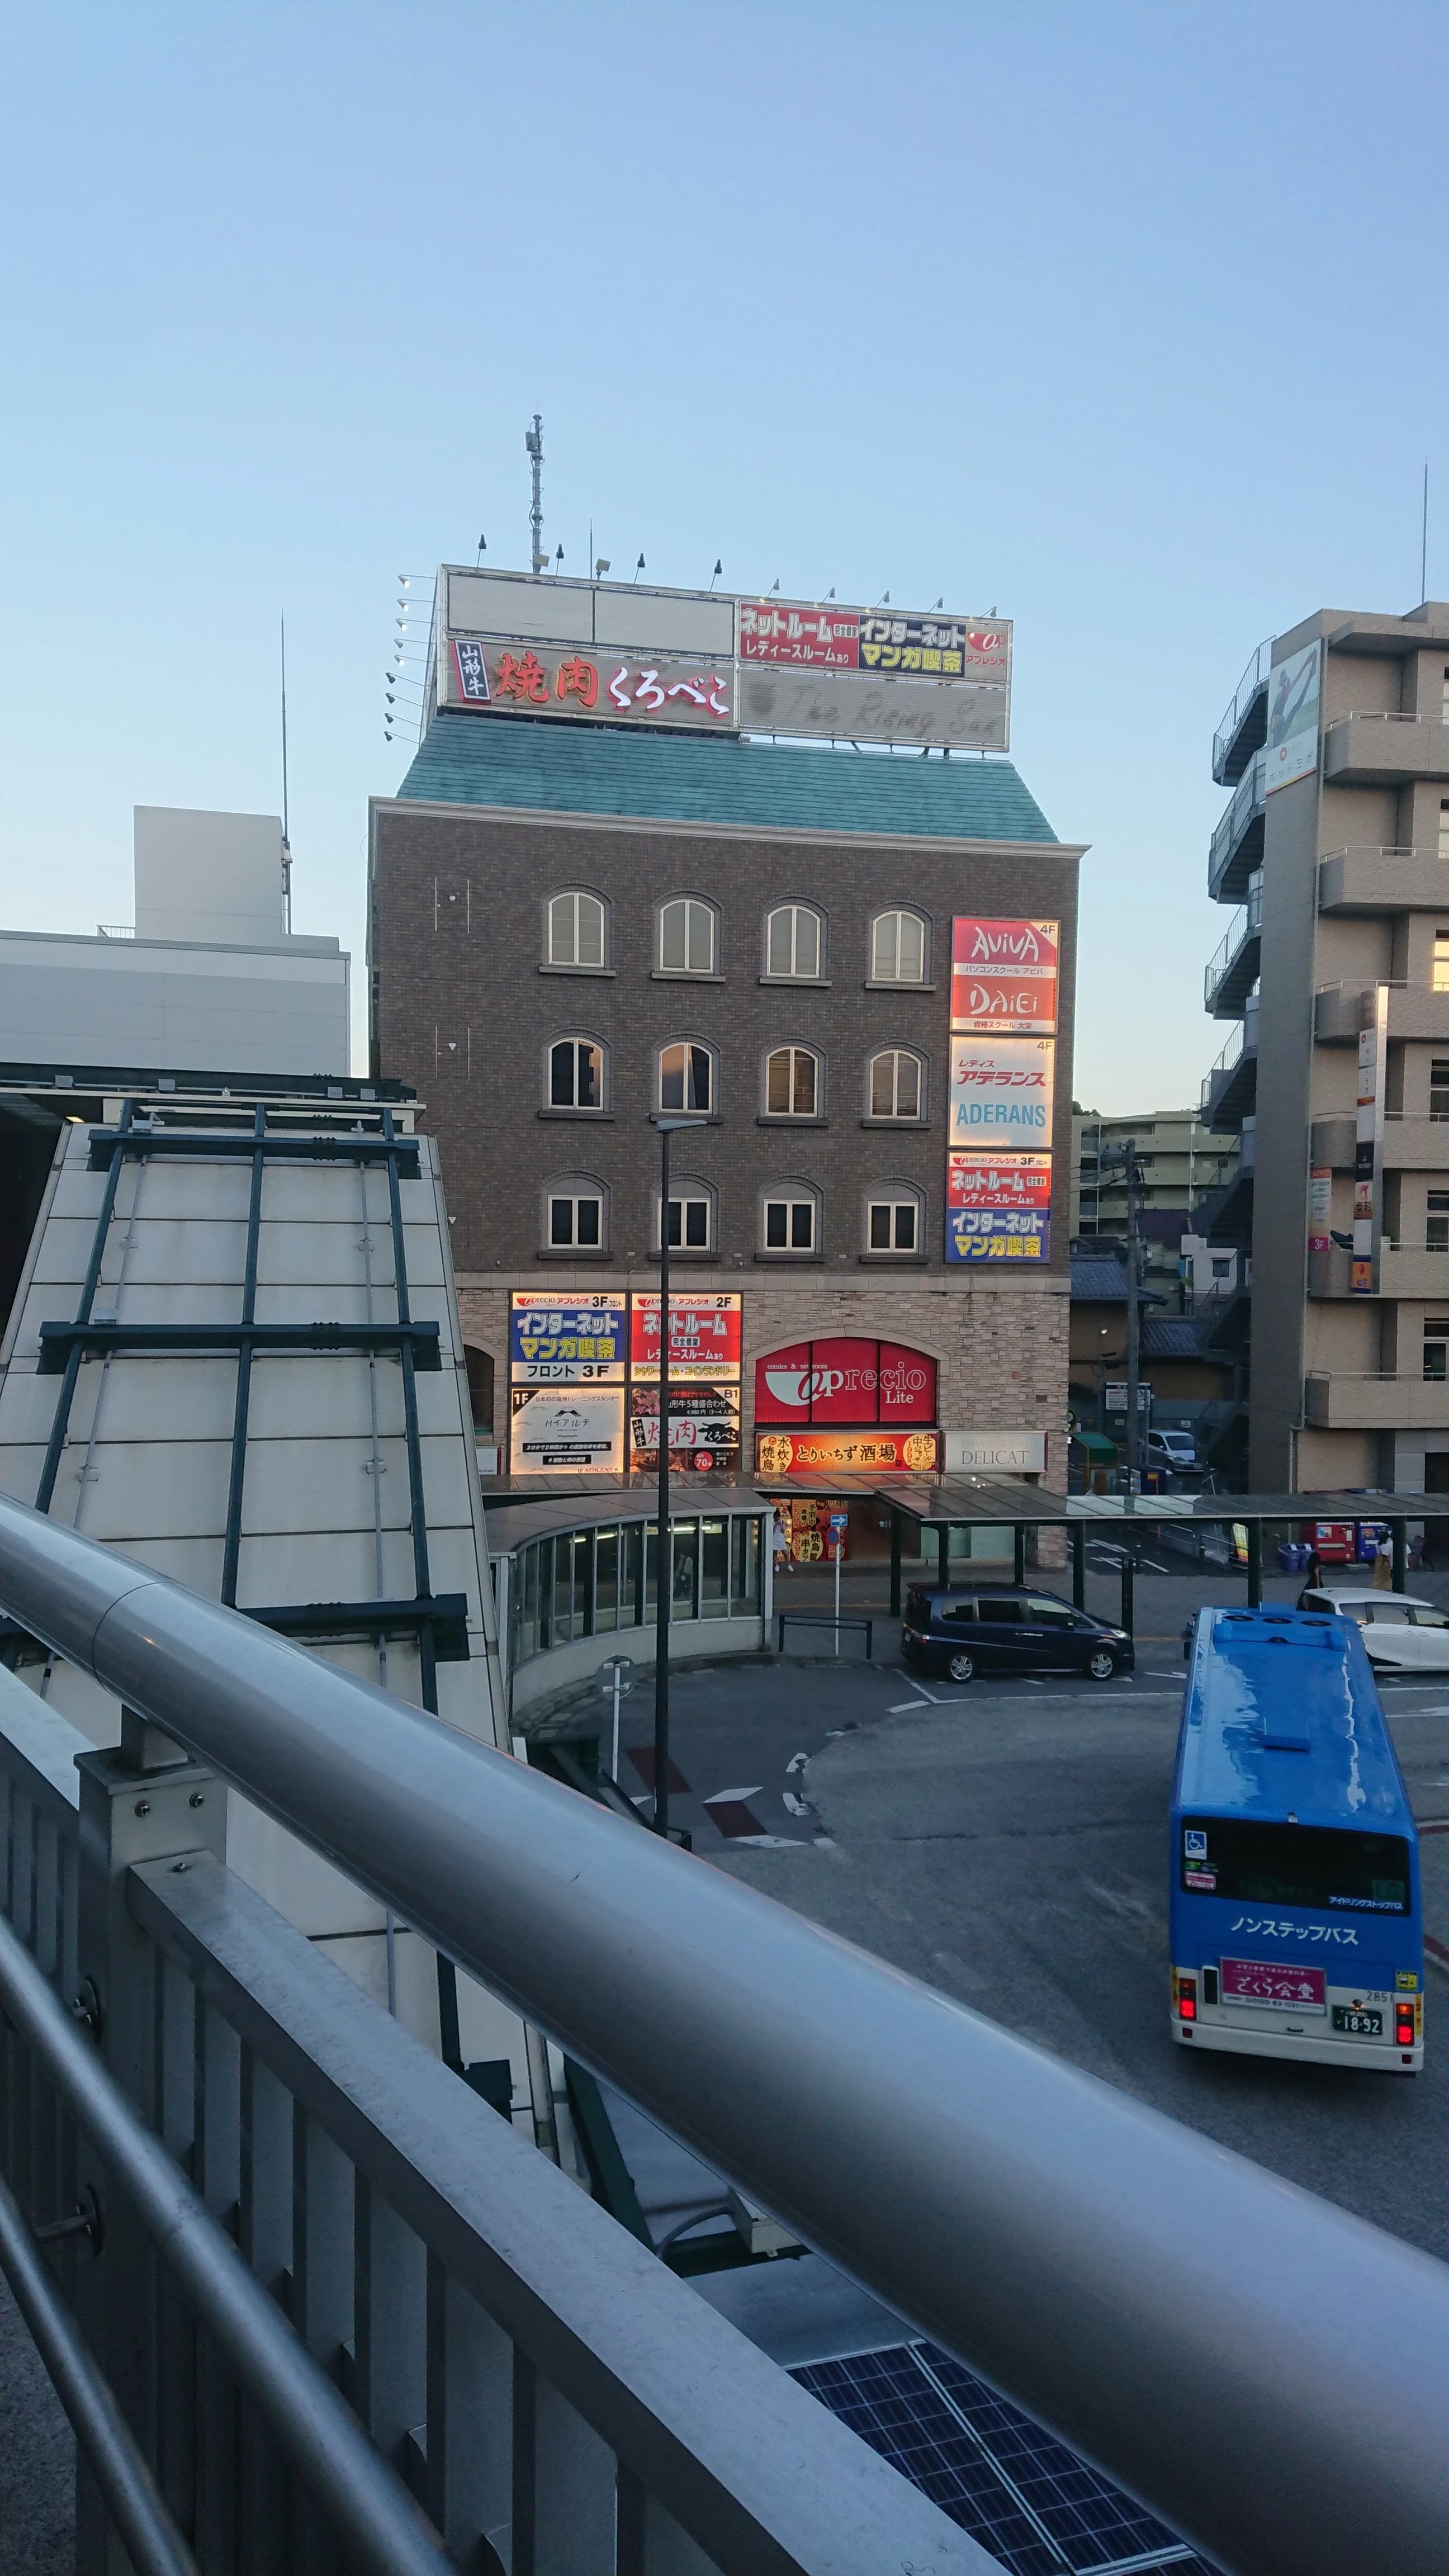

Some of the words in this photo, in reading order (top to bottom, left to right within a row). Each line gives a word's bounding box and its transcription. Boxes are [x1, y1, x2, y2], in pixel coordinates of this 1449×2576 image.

[741, 608, 834, 642] ネットルーム
[859, 618, 966, 648] インターネット
[746, 640, 849, 664] レディースルームあり
[861, 643, 963, 673] マンガ喫茶
[462, 645, 485, 696] 山形牛
[496, 650, 599, 708] 焼肉
[609, 667, 730, 716] くろべこ
[1040, 925, 1055, 934] 4F
[965, 965, 1020, 974] パソコンスクール
[973, 1020, 1016, 1029] 資格スクール
[1036, 1041, 1053, 1050] 4F
[958, 1059, 995, 1068] レディス
[956, 1071, 1046, 1087] アデランス
[956, 1104, 1046, 1128] ADERANS
[1020, 1157, 1035, 1166] 3F
[951, 1169, 1025, 1192] ネットルーム
[963, 1193, 1035, 1205] レディースルームあり
[952, 1211, 1045, 1234] インターネット
[954, 1235, 1042, 1257] マンガ喫茶
[1314, 1238, 1324, 1251] 3F
[592, 1296, 608, 1308] 3F
[716, 1296, 732, 1308] 2F
[517, 1312, 619, 1336] インターネット
[520, 1337, 615, 1360] マンガ喫茶
[673, 1337, 699, 1347] 完全個室
[527, 1365, 575, 1377] フロント
[582, 1365, 609, 1378] 3F
[798, 1361, 927, 1401] aprecio
[514, 1393, 529, 1405] 1F
[724, 1389, 738, 1399] B1
[885, 1390, 915, 1404] Lite
[633, 1420, 646, 1447] 山形牛
[761, 1446, 775, 1471] 焼鳥
[777, 1436, 790, 1471] 水炊き
[798, 1443, 896, 1462] とりいちず酒場
[961, 1450, 1029, 1465] DELICAT
[1230, 1917, 1359, 1945] ノンステップバス
[1344, 2015, 1380, 2034] 18-92
